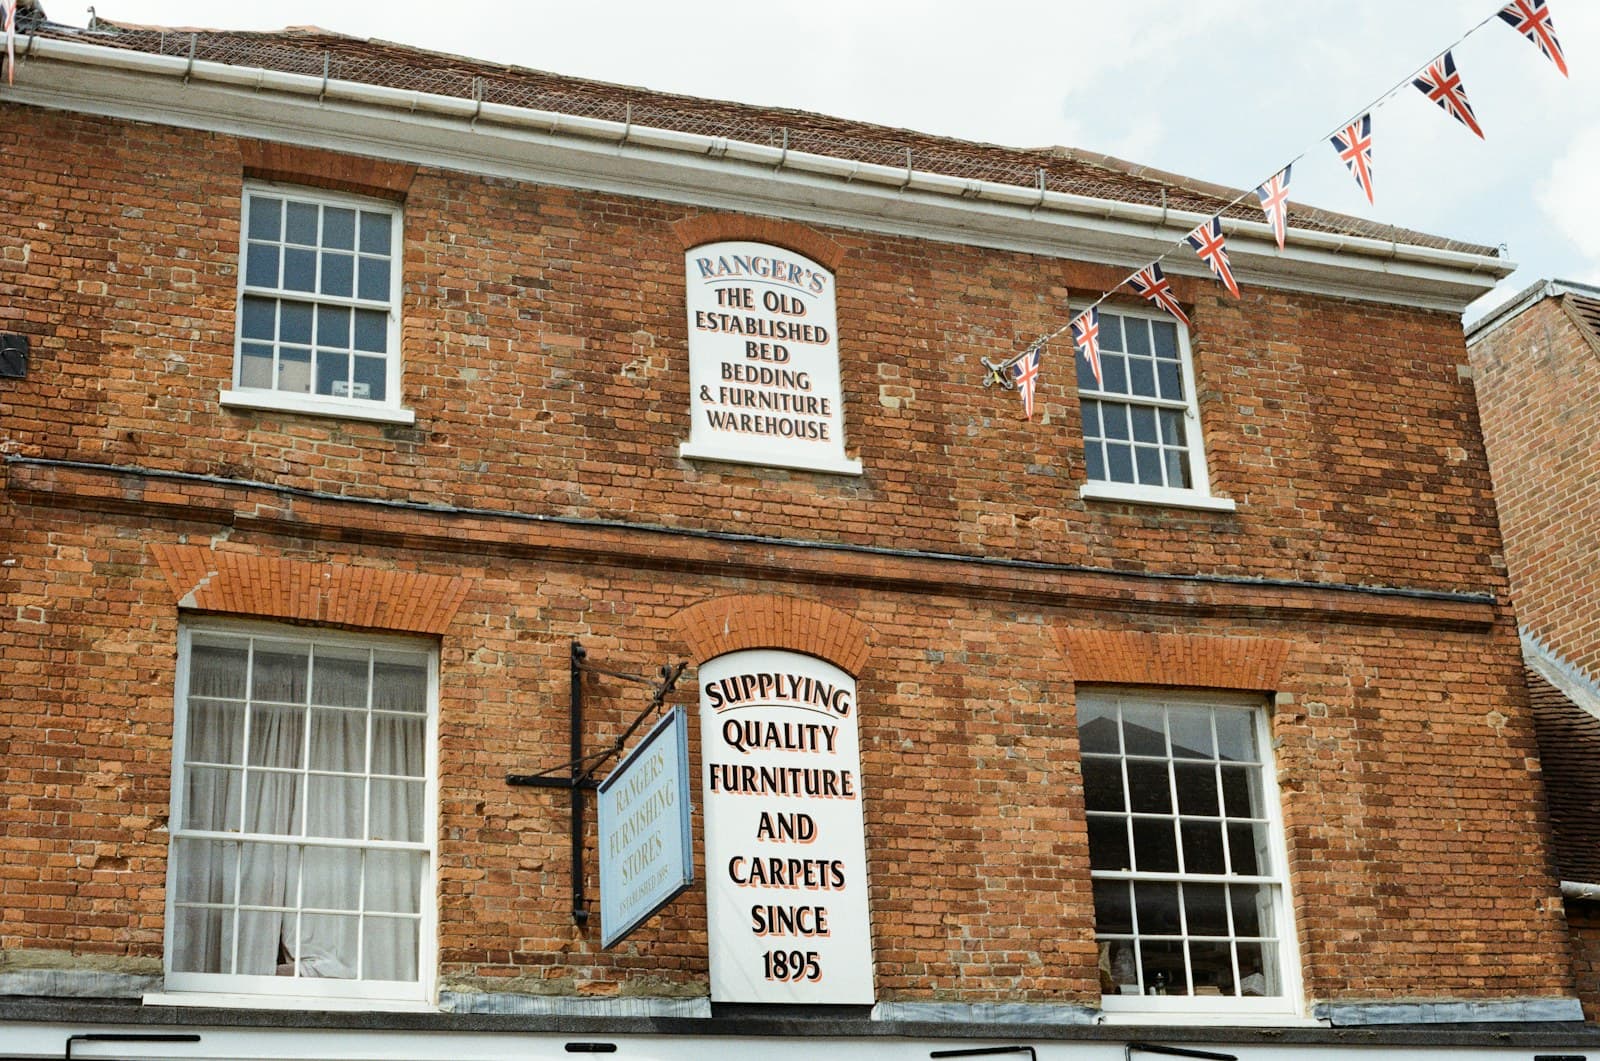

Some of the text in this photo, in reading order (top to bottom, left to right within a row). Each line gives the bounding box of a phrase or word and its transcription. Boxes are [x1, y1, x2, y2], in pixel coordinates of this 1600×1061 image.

[696, 255, 827, 293] RANGER'S
[715, 288, 806, 317] THE OLD
[695, 310, 830, 345] ESTABLISHED
[745, 341, 790, 363] BED
[721, 362, 811, 392] BEDDING
[699, 385, 832, 418] & FURNITURE
[706, 410, 831, 442] WAREHOUSE
[705, 673, 851, 719] SUPPLYING
[722, 719, 838, 754] QUALITY
[615, 748, 665, 817] RANGERS
[709, 763, 856, 798] FURNITURE
[608, 779, 674, 860] FURNISHING
[756, 811, 817, 844] AND
[622, 830, 663, 887] STORES
[728, 856, 847, 891] CARPETS
[751, 904, 831, 938] SINCE
[762, 951, 823, 983] 1895
